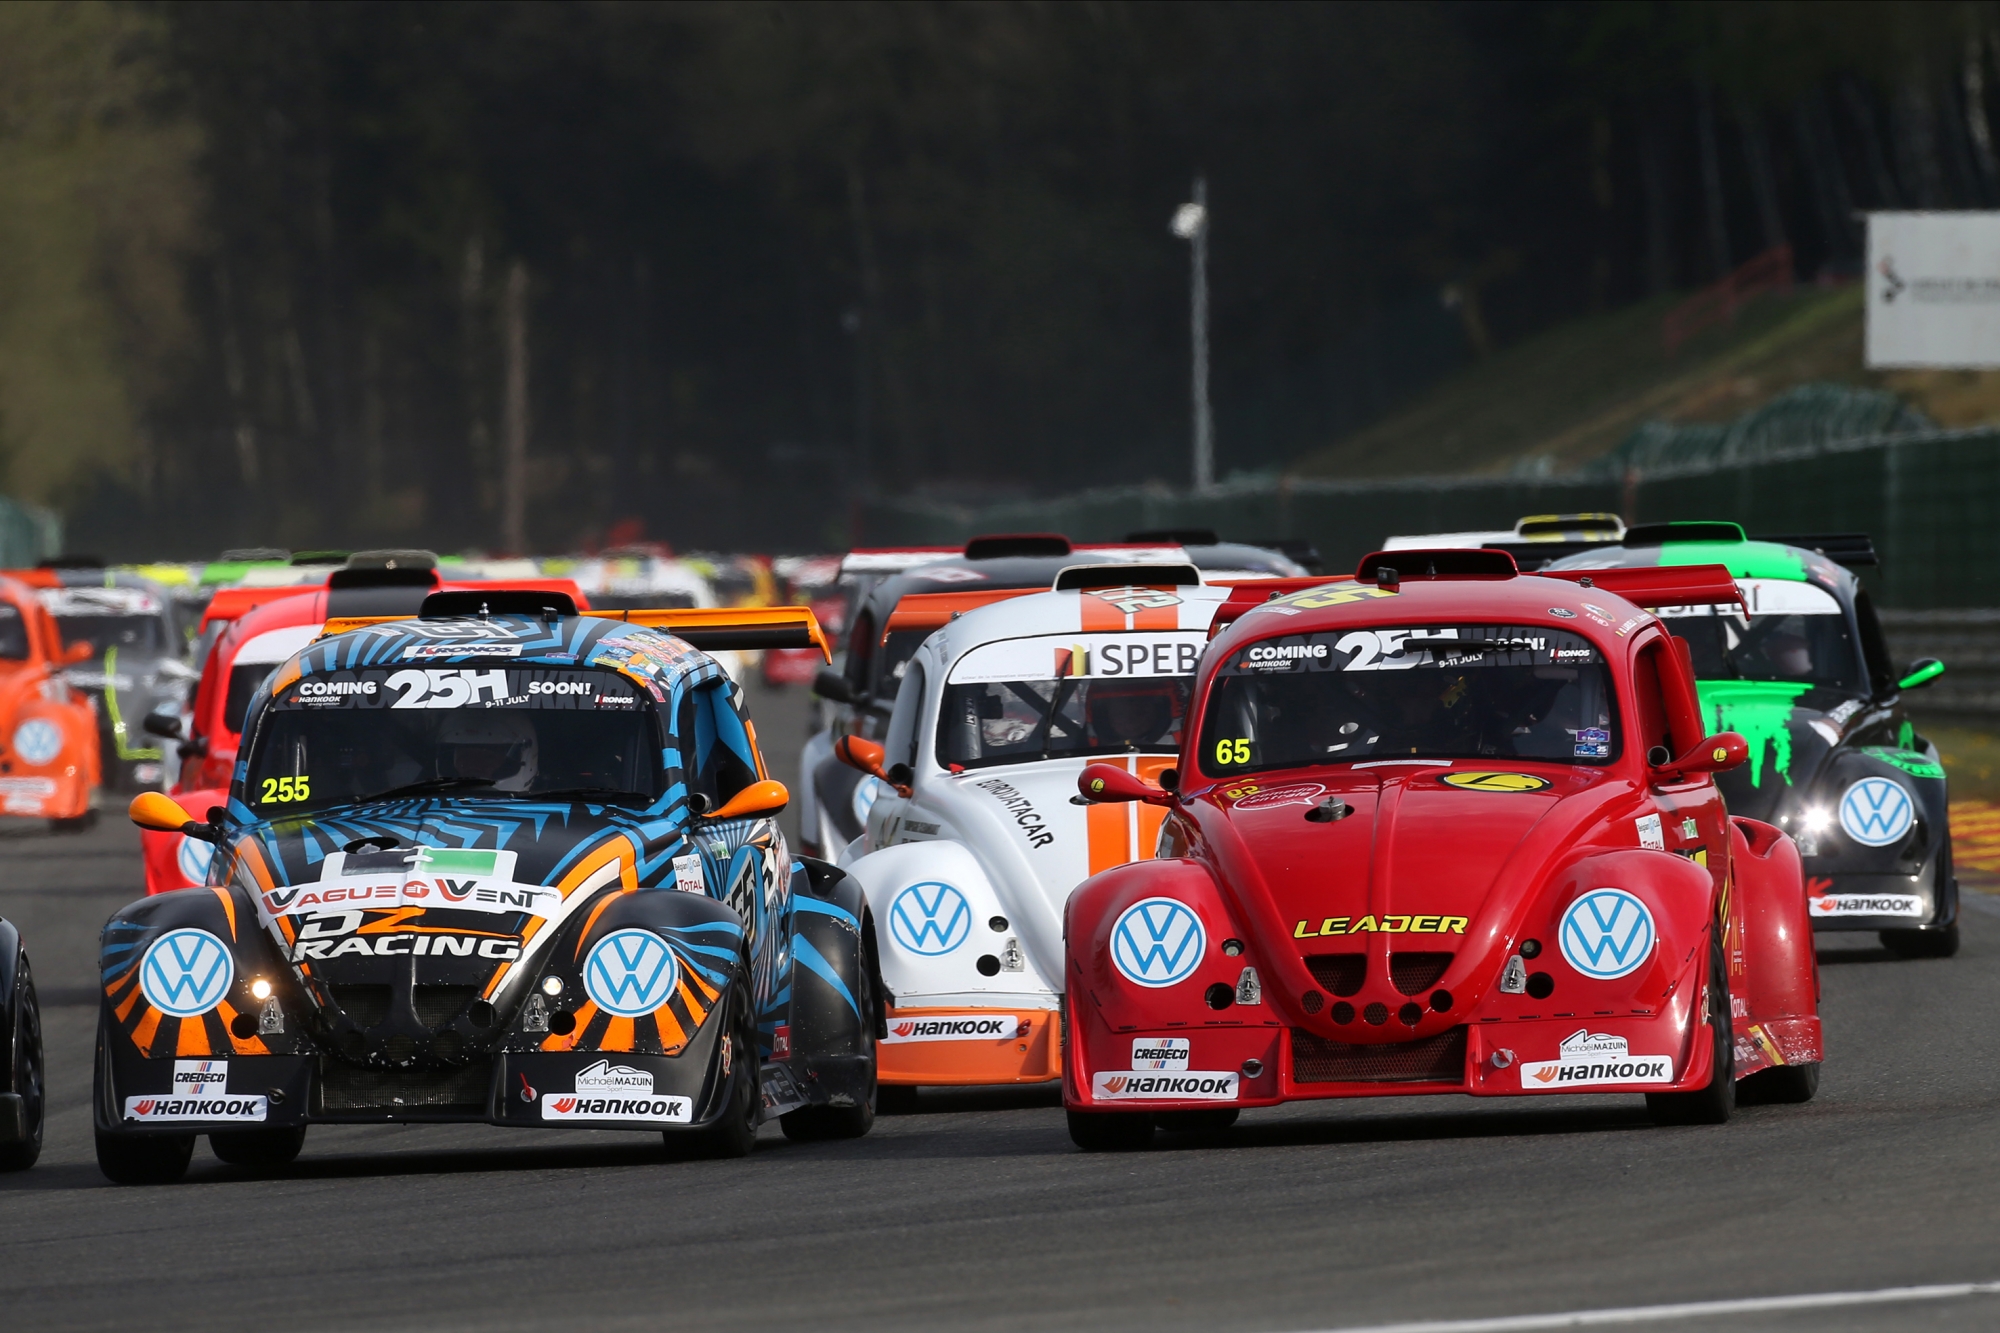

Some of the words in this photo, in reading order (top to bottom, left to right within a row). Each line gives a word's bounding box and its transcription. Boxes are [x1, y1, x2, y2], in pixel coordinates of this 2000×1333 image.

[416, 646, 514, 654] KRONOS
[1249, 645, 1327, 660] COMING
[1549, 648, 1590, 658] KRONOS
[1100, 643, 1206, 675] SPEB
[1438, 659, 1458, 669] 9-11
[1460, 652, 1484, 664] JULY
[300, 681, 377, 695] COMING
[384, 669, 509, 708] 25H
[528, 681, 591, 694] SOON!
[485, 699, 504, 709] 9-11
[506, 695, 530, 704] JULY
[594, 694, 634, 704] KRONOS
[1216, 738, 1251, 765] 65
[261, 776, 310, 803] 255
[976, 779, 1054, 849] EURODATACAR
[679, 878, 703, 892] TOTAL
[262, 886, 397, 914] VAGUE
[434, 878, 544, 908] VENT
[1293, 915, 1469, 938] LEADER
[291, 935, 520, 962] RACING
[1134, 1049, 1188, 1060] CREDECO
[175, 1073, 226, 1083] CREDECO
